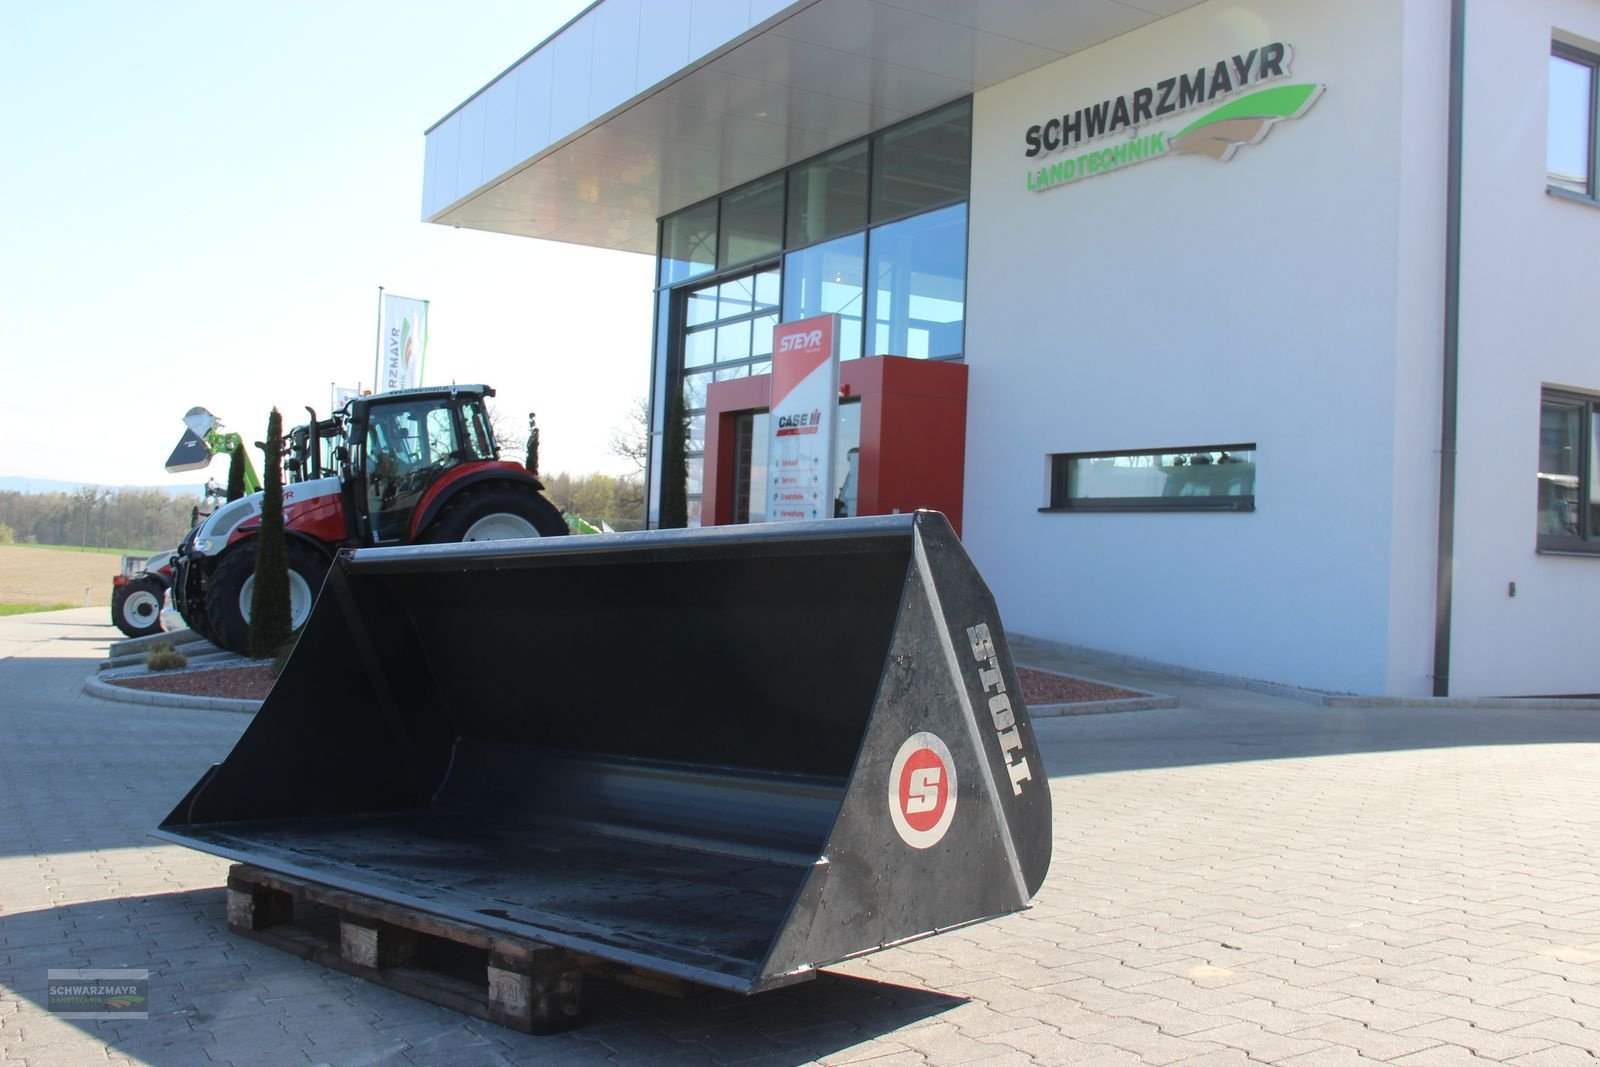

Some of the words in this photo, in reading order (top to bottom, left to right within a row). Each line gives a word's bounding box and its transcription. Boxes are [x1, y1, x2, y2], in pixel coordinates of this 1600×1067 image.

[1025, 42, 1286, 158] SCHWARZMAYR
[1026, 130, 1166, 191] LANDTECHNIK
[779, 329, 822, 352] STEYR
[778, 413, 809, 428] CASE
[966, 622, 1033, 797] STOLL
[906, 766, 942, 815] S
